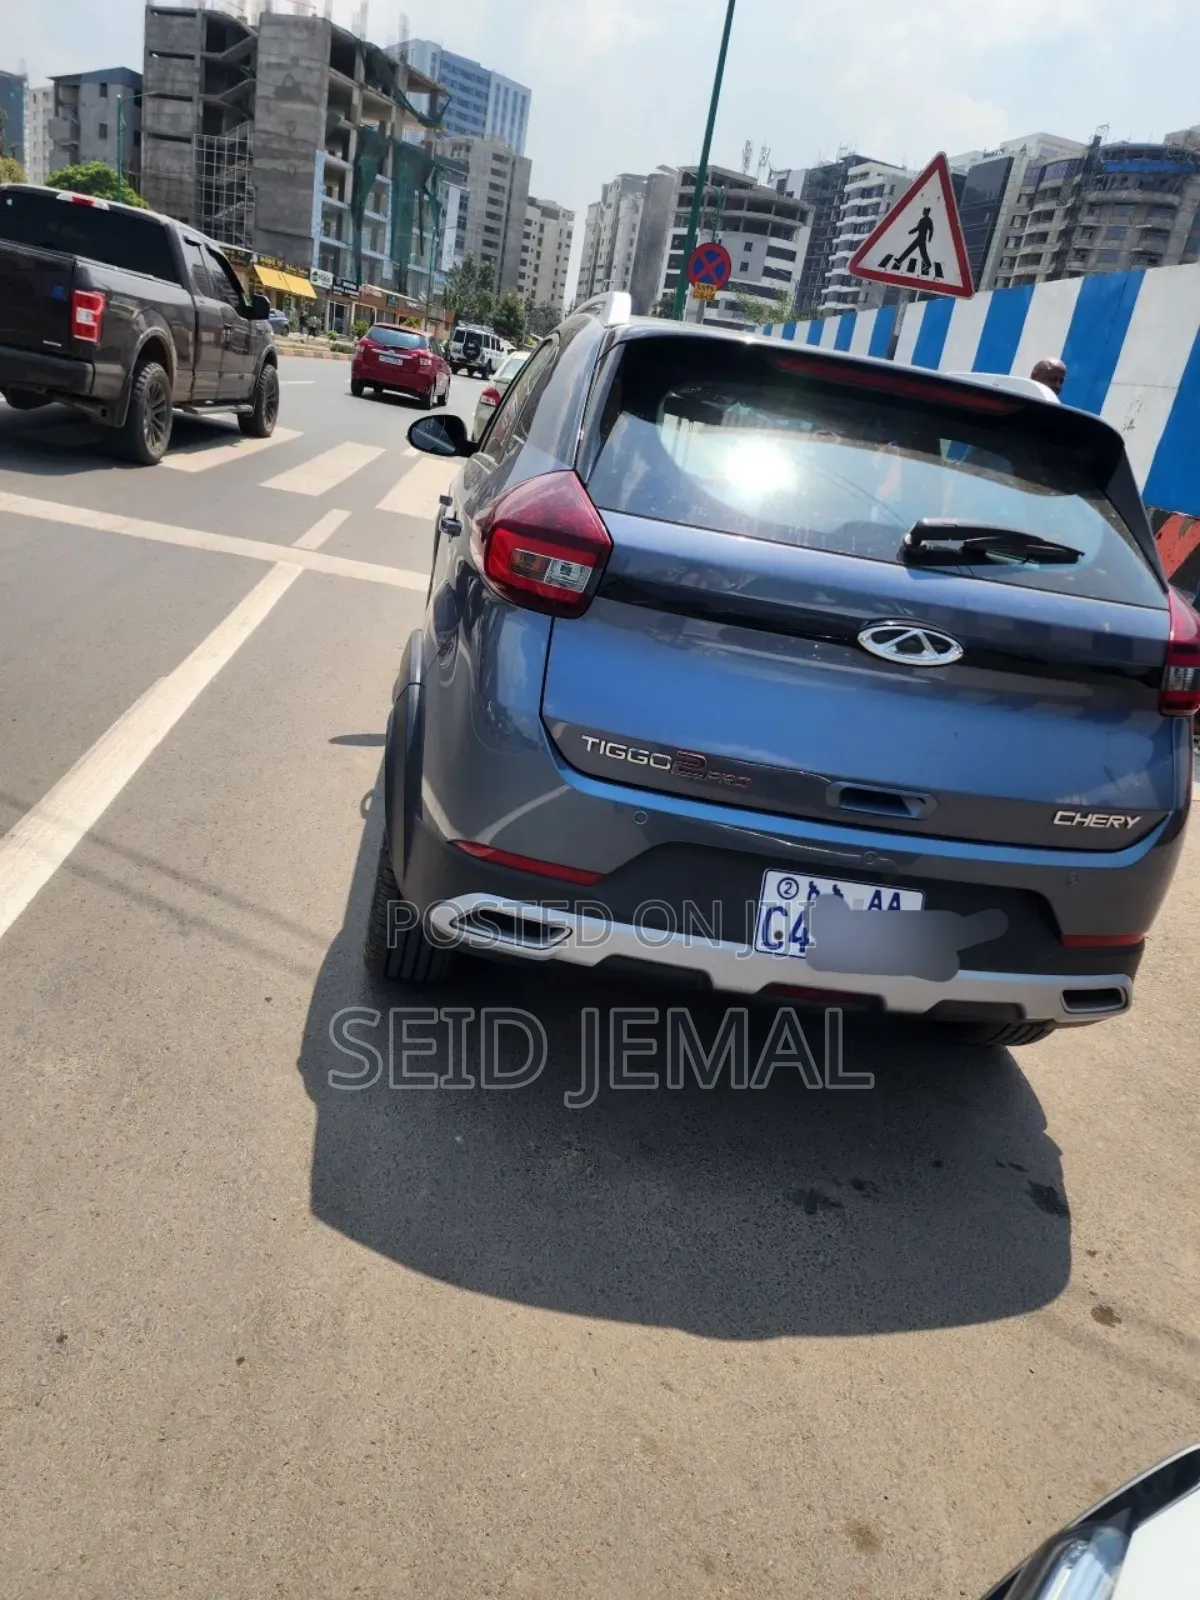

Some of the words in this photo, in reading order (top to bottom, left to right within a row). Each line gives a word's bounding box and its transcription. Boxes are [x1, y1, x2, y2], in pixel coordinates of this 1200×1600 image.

[581, 734, 671, 771] TIGGO
[1053, 810, 1141, 829] CHERY
[867, 889, 901, 911] AA
